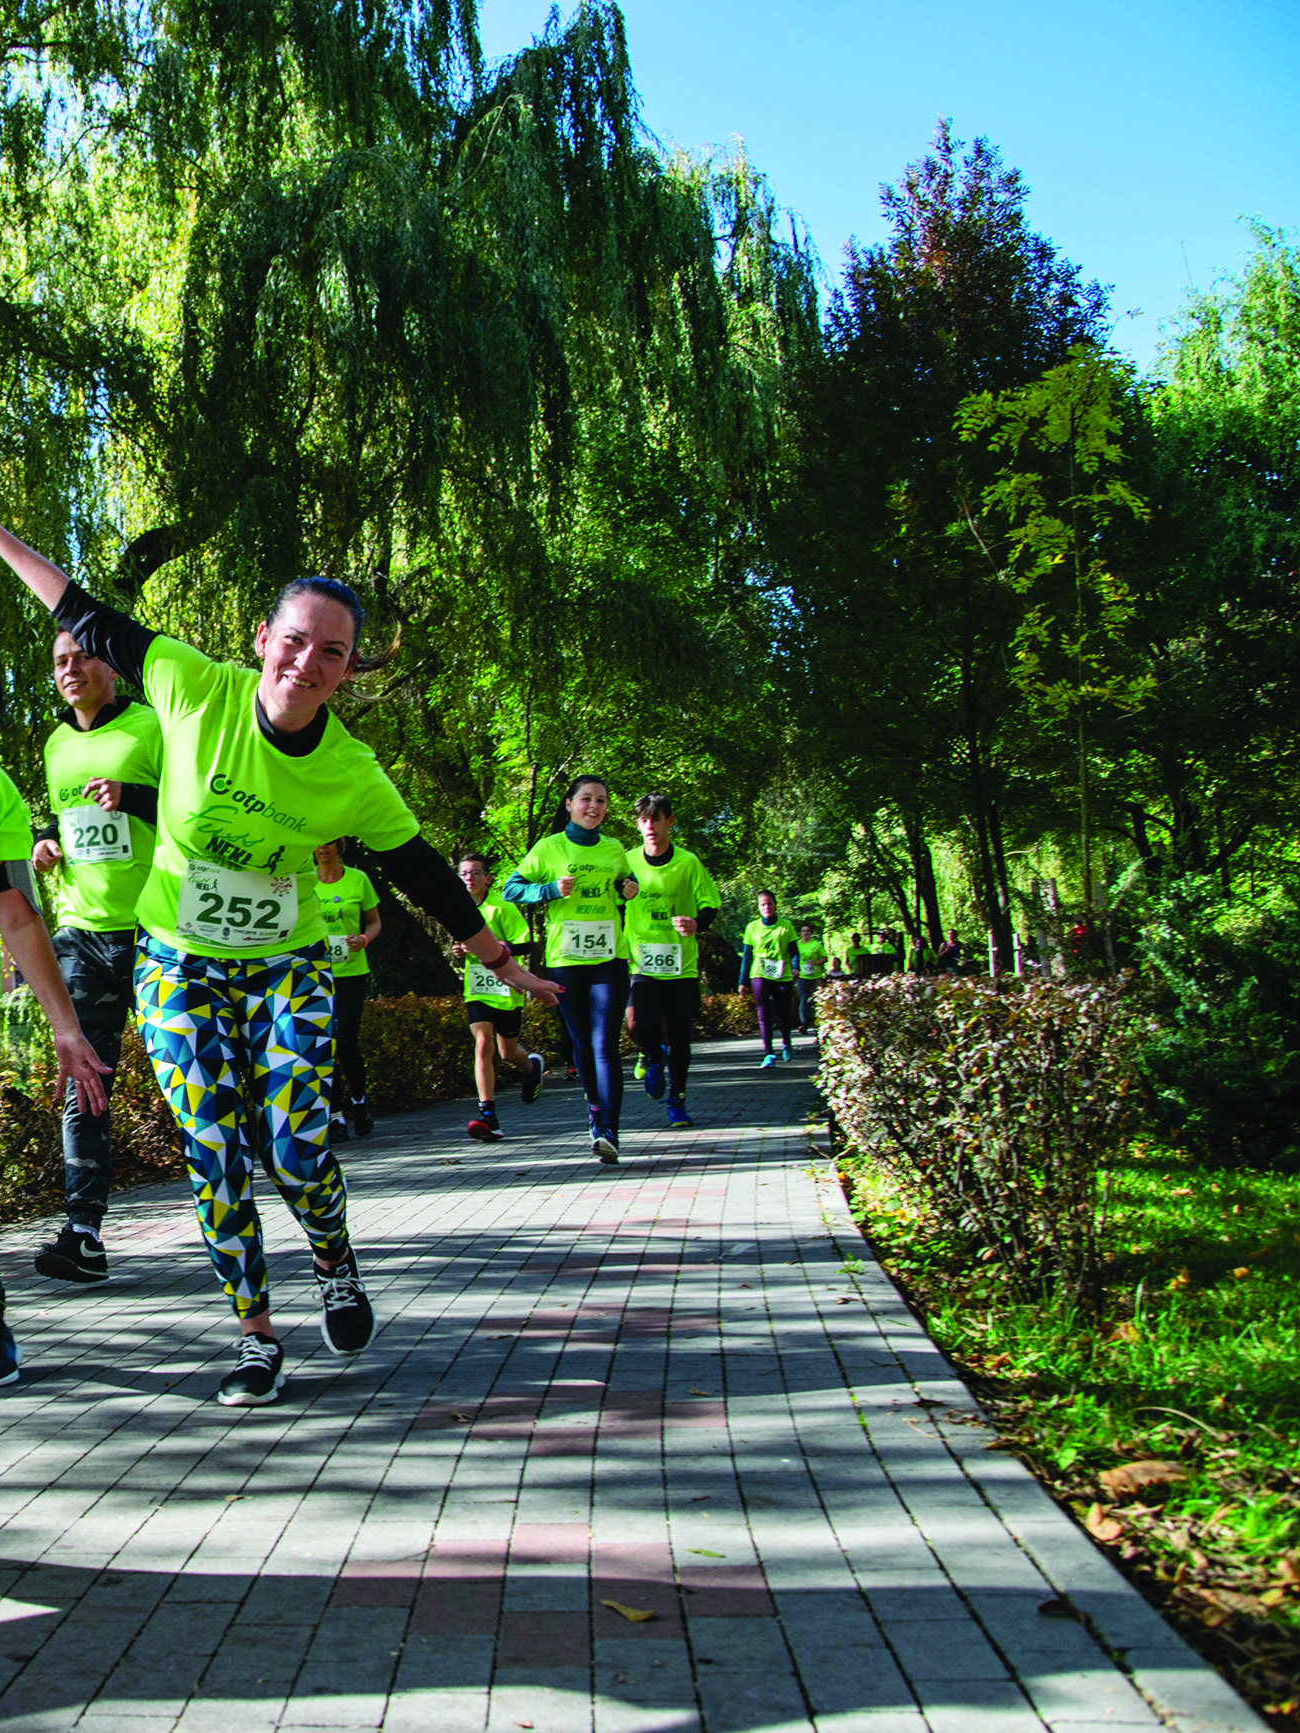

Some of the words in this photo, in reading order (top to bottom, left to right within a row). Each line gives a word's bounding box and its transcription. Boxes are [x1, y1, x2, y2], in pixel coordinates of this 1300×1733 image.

[232, 789, 307, 832] otpbank
[73, 823, 119, 849] 220
[204, 836, 253, 866] NEKI
[196, 891, 281, 930] 252
[571, 934, 607, 949] 154
[644, 954, 675, 967] 266
